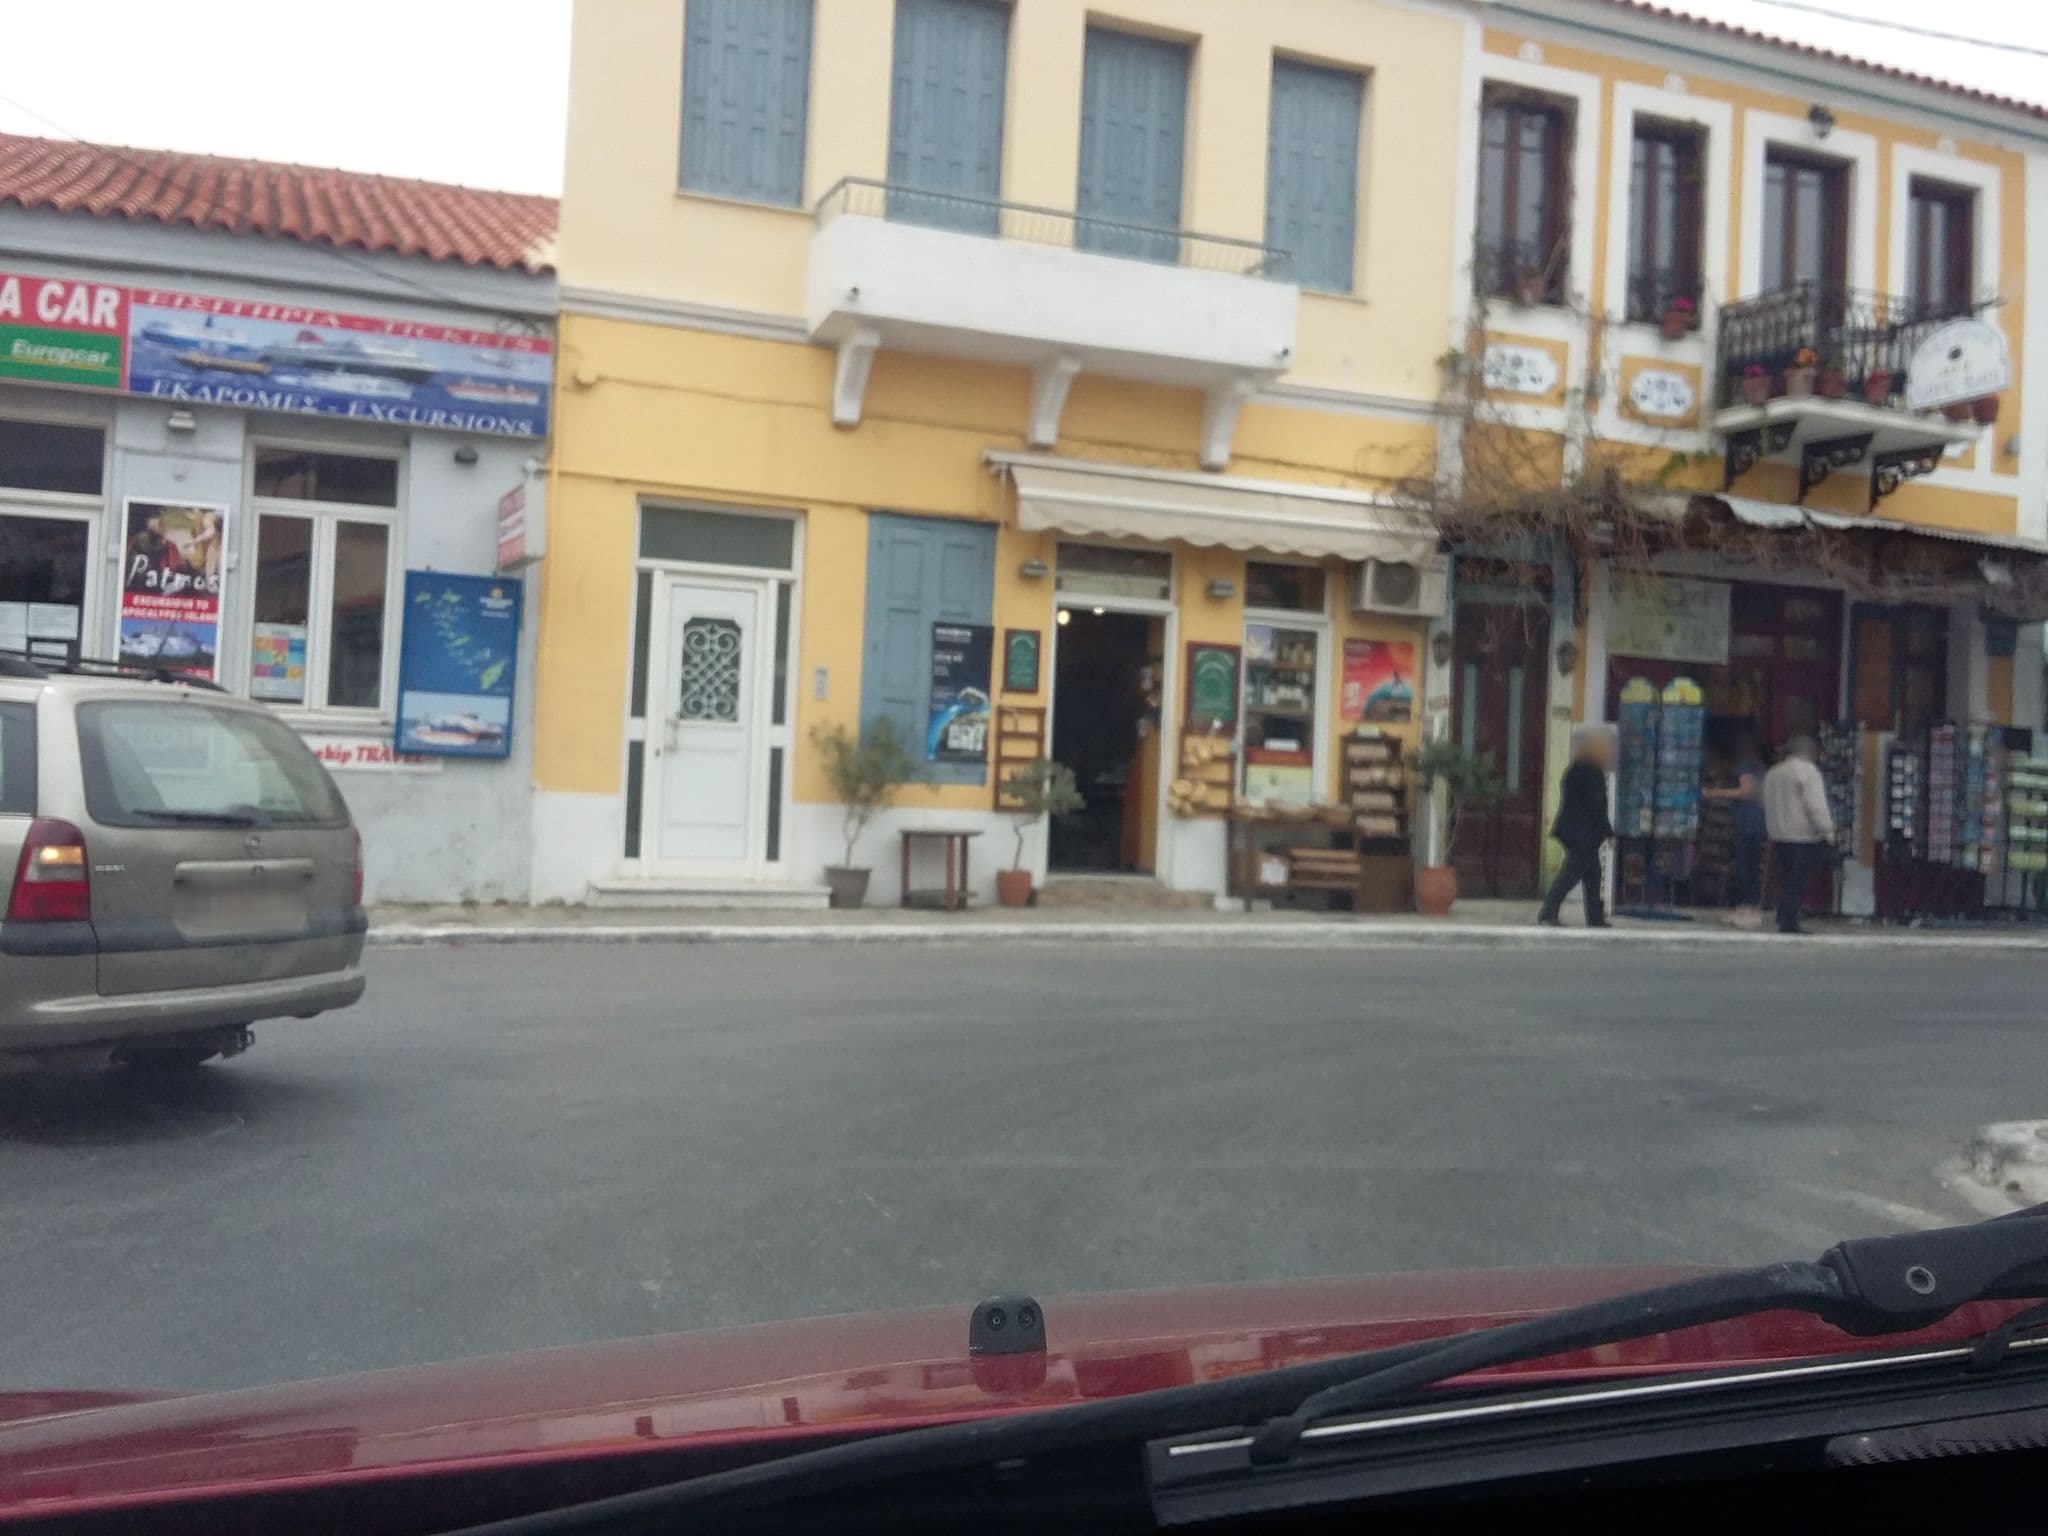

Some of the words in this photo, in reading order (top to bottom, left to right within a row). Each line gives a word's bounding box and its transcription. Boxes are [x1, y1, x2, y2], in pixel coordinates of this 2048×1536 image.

[37, 281, 120, 329] CAR
[11, 338, 112, 366] Europcar
[381, 320, 534, 349] TICKETS
[347, 400, 535, 436] EXCURSIONS
[127, 553, 220, 596] Patmos
